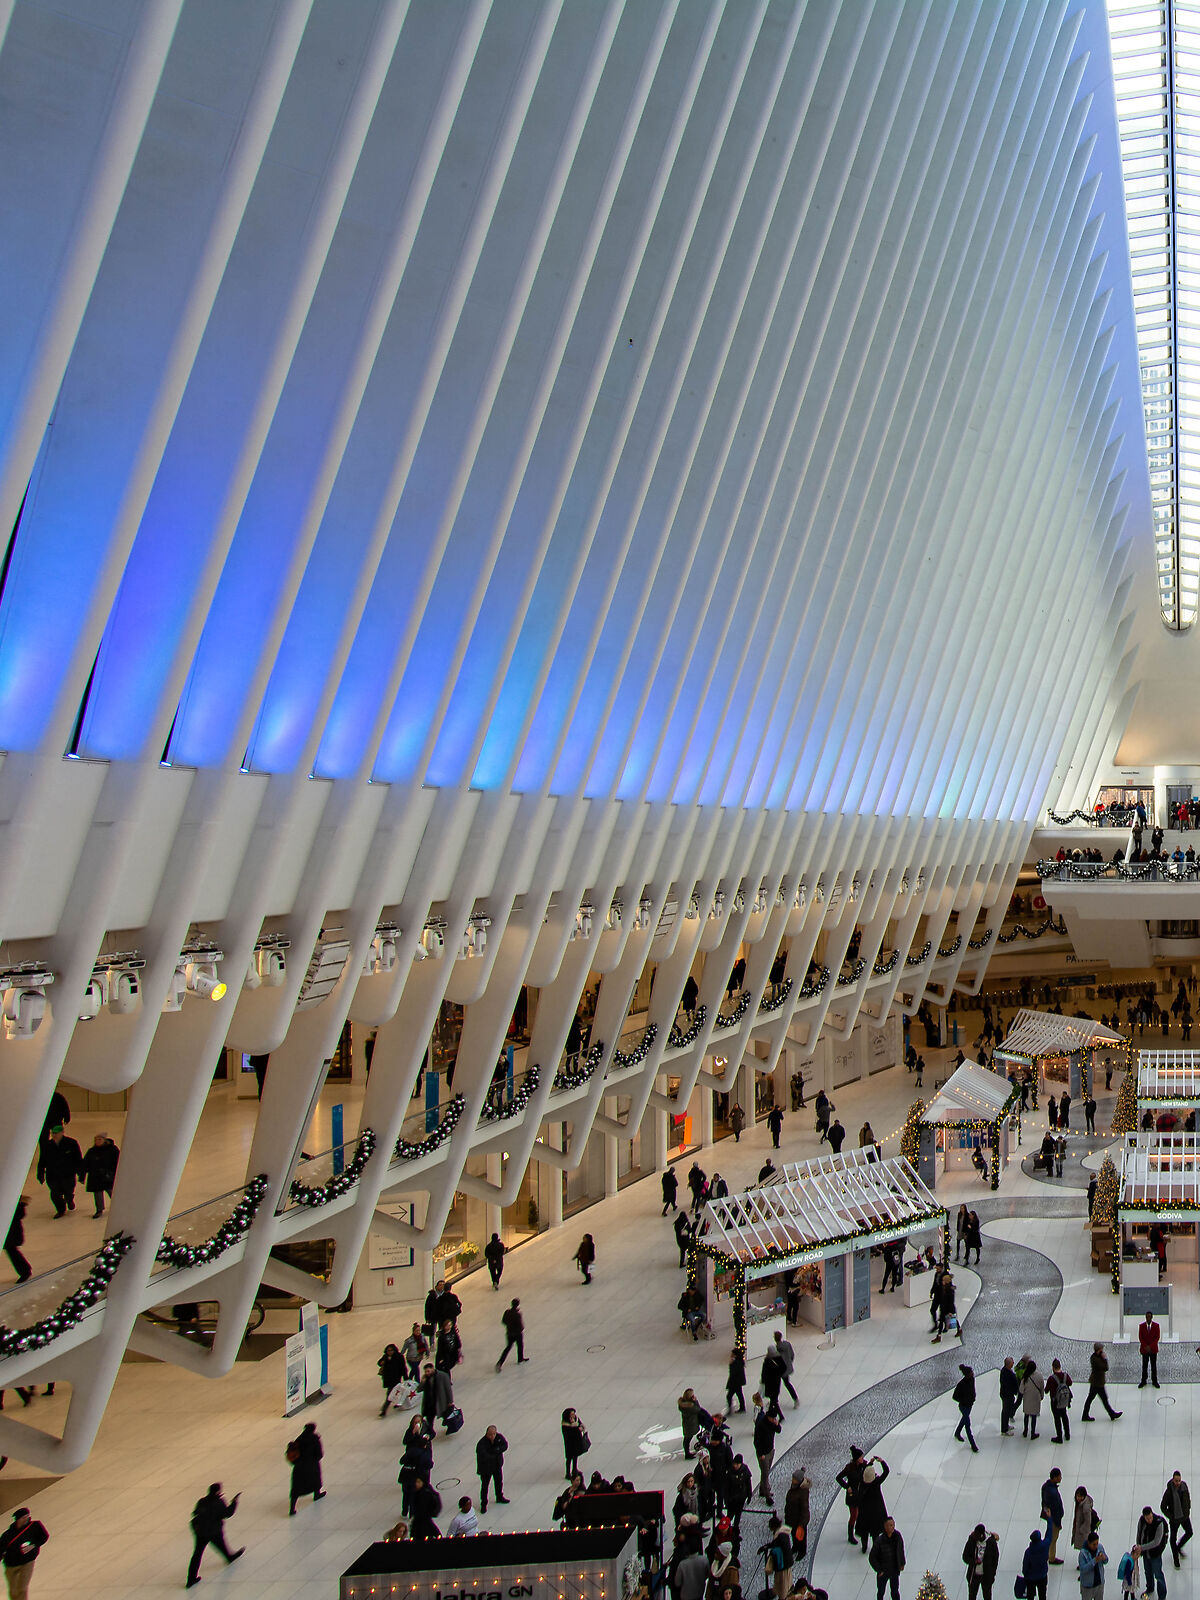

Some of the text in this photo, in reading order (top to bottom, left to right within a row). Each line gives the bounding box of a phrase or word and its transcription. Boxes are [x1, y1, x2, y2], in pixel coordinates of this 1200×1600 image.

[1157, 1212, 1183, 1220] GODIVA
[874, 1221, 926, 1242] FLOGA NEW YORK
[776, 1250, 824, 1269] WILLOW ROAD
[508, 1585, 533, 1598] GN
